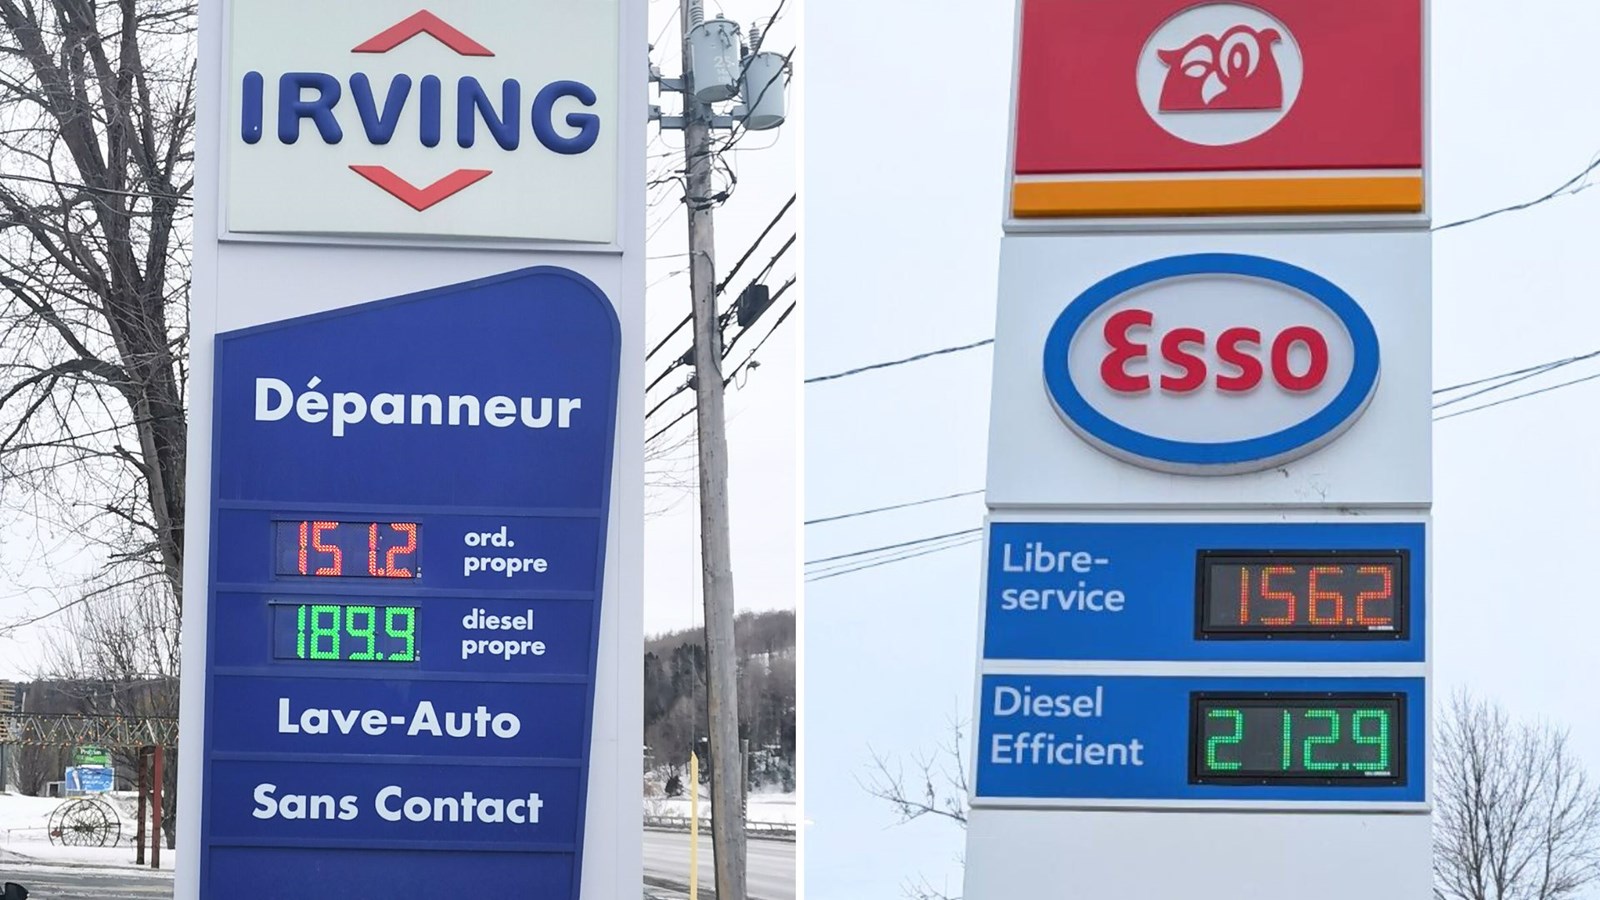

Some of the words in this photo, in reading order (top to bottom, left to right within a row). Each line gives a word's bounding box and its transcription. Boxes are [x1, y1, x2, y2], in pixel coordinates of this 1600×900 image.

[241, 70, 600, 155] IRVING
[1099, 309, 1329, 393] Esso
[255, 375, 582, 437] Dépanneur
[297, 520, 417, 578] 151.2
[463, 526, 515, 548] ord.
[463, 555, 548, 578] propre
[1002, 542, 1110, 573] Libre-
[1001, 580, 1126, 612] service
[1240, 566, 1392, 626] 156.2
[297, 604, 416, 662] 189.9
[462, 608, 534, 631] diesel
[461, 638, 546, 661] propre
[278, 697, 521, 739] Lave-Auto
[993, 685, 1104, 718] Diesel
[990, 731, 1145, 767] Efficient
[252, 783, 359, 821] Sans
[374, 785, 544, 824] Contact
